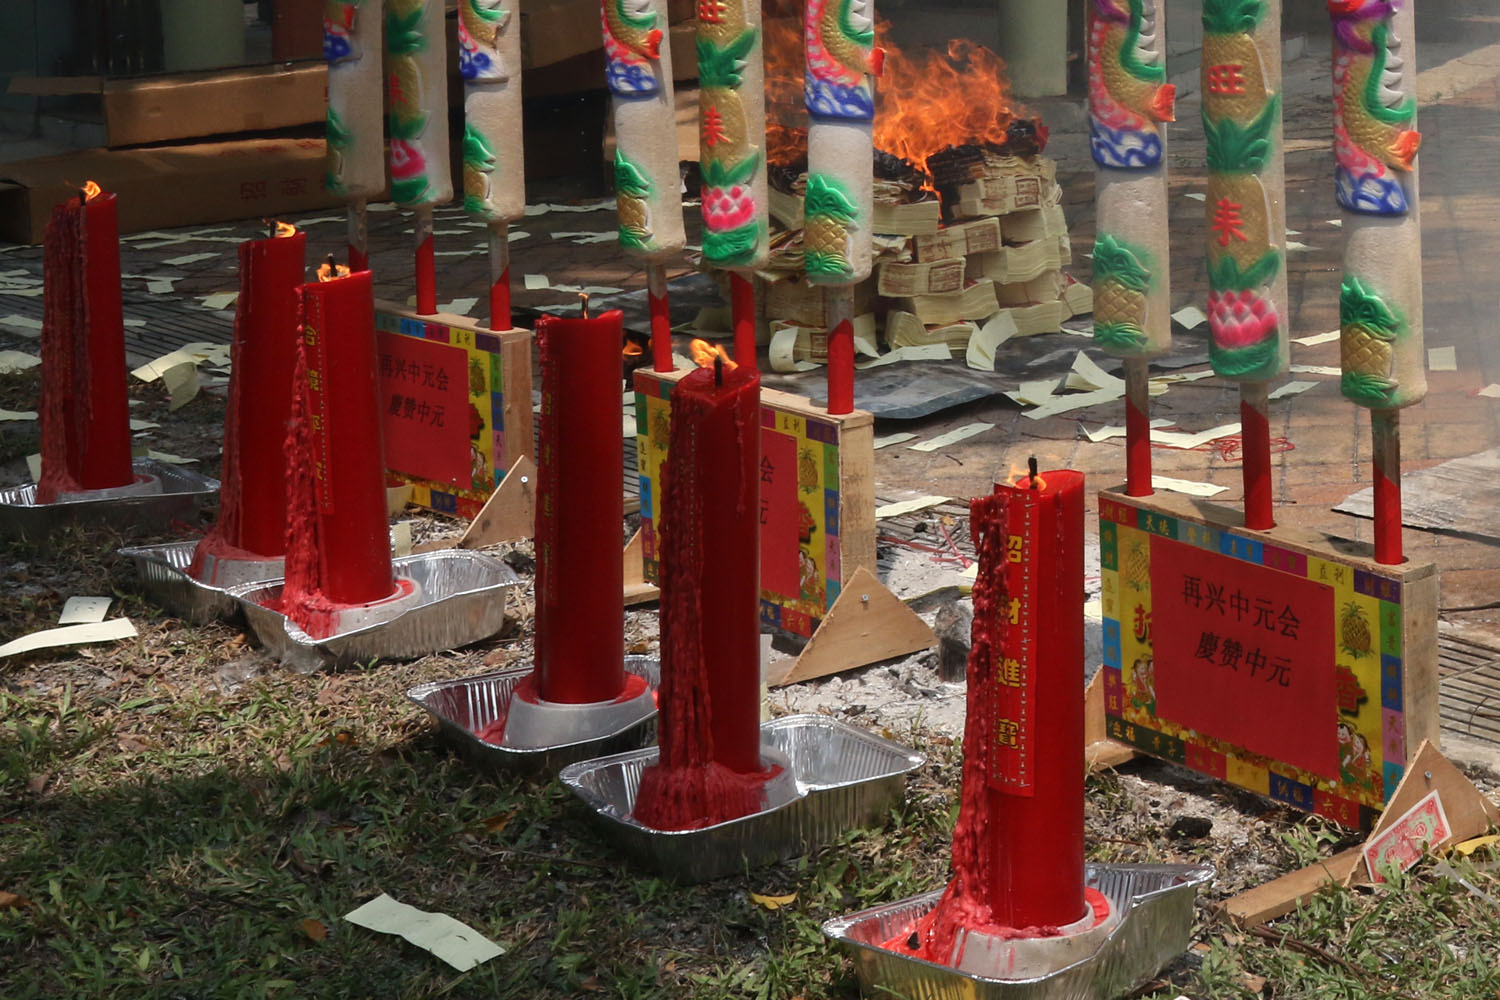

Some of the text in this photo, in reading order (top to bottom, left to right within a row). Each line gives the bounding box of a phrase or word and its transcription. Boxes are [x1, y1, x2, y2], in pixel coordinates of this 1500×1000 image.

[1181, 573, 1301, 641] 再兴中元会
[1195, 631, 1293, 688] 慶赞中元
